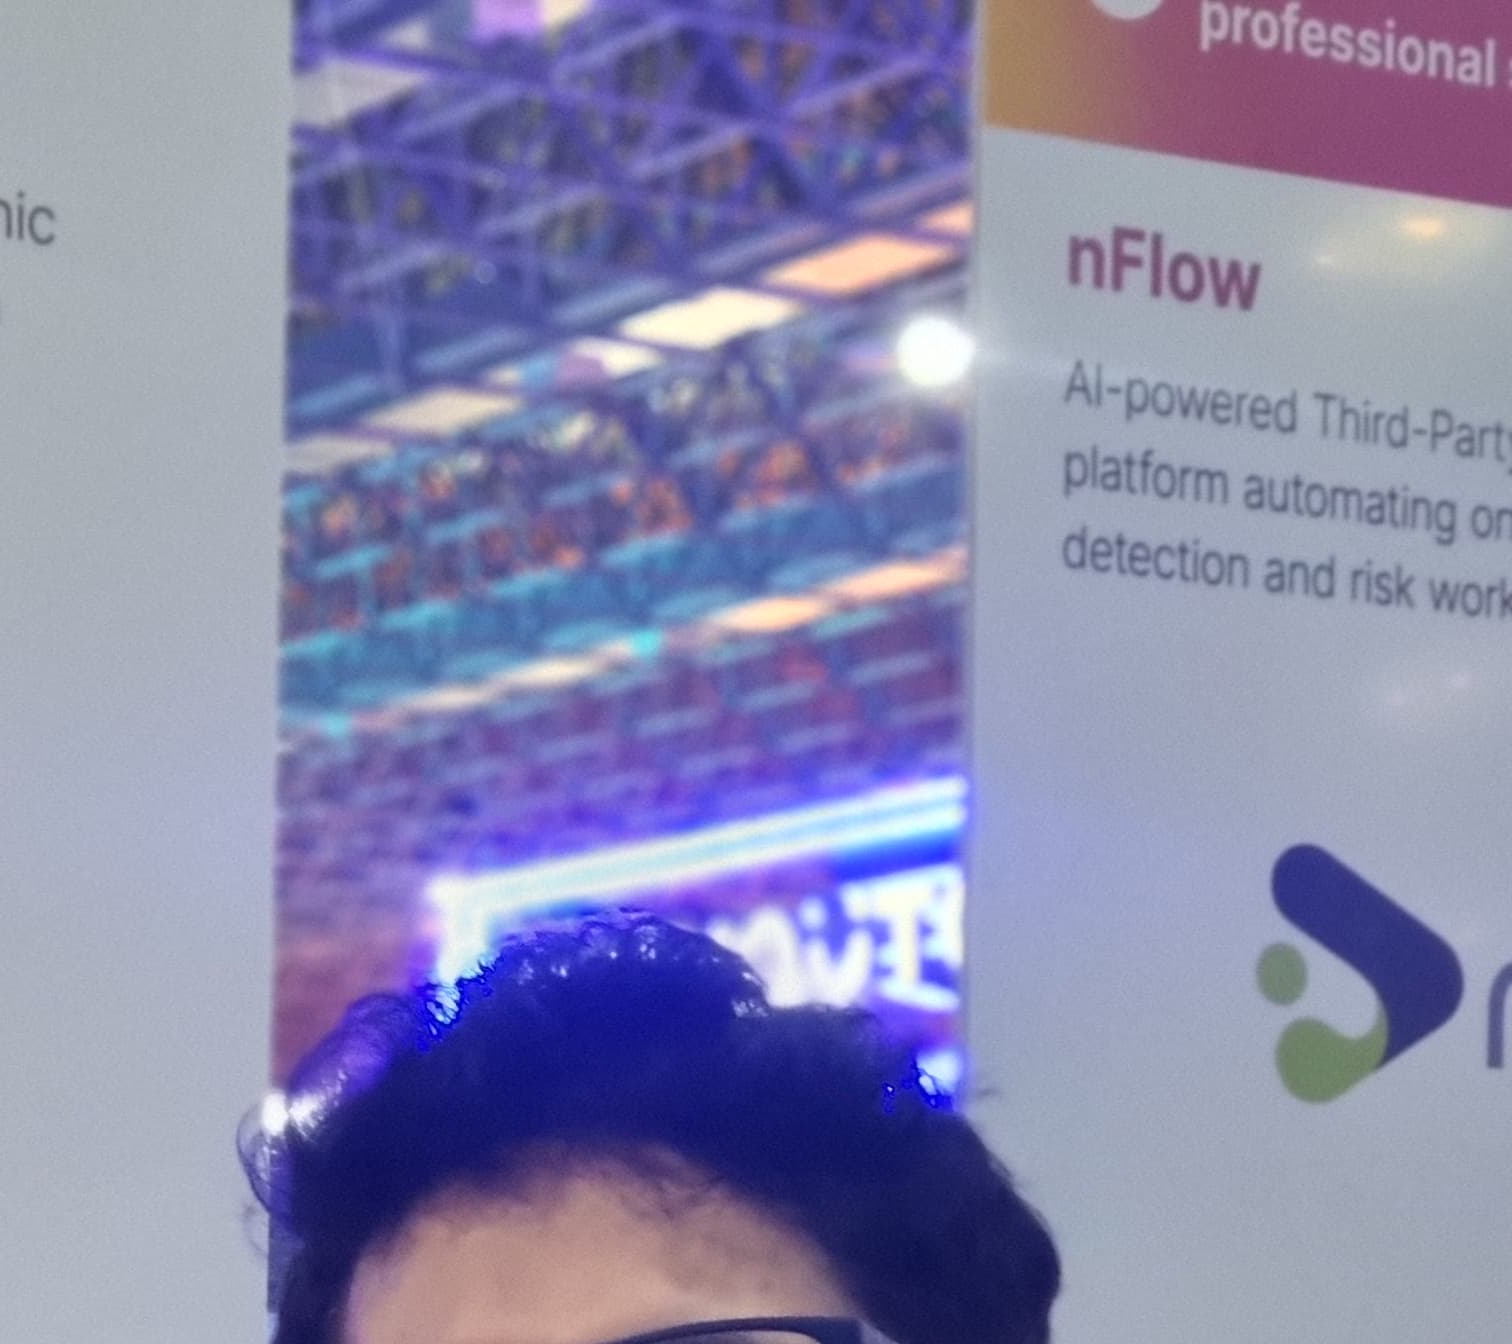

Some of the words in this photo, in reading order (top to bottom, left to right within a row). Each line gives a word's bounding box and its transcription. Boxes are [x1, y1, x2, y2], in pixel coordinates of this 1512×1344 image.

[1199, 0, 1496, 88] professional
[1068, 226, 1262, 312] nFlow
[1064, 358, 1298, 436] AI-powered
[1313, 391, 1512, 476] Third-Part
[1063, 447, 1229, 506] platform
[1243, 473, 1456, 547] automating
[1062, 526, 1249, 590] detection
[1263, 553, 1336, 602] and
[1349, 565, 1416, 609] risk
